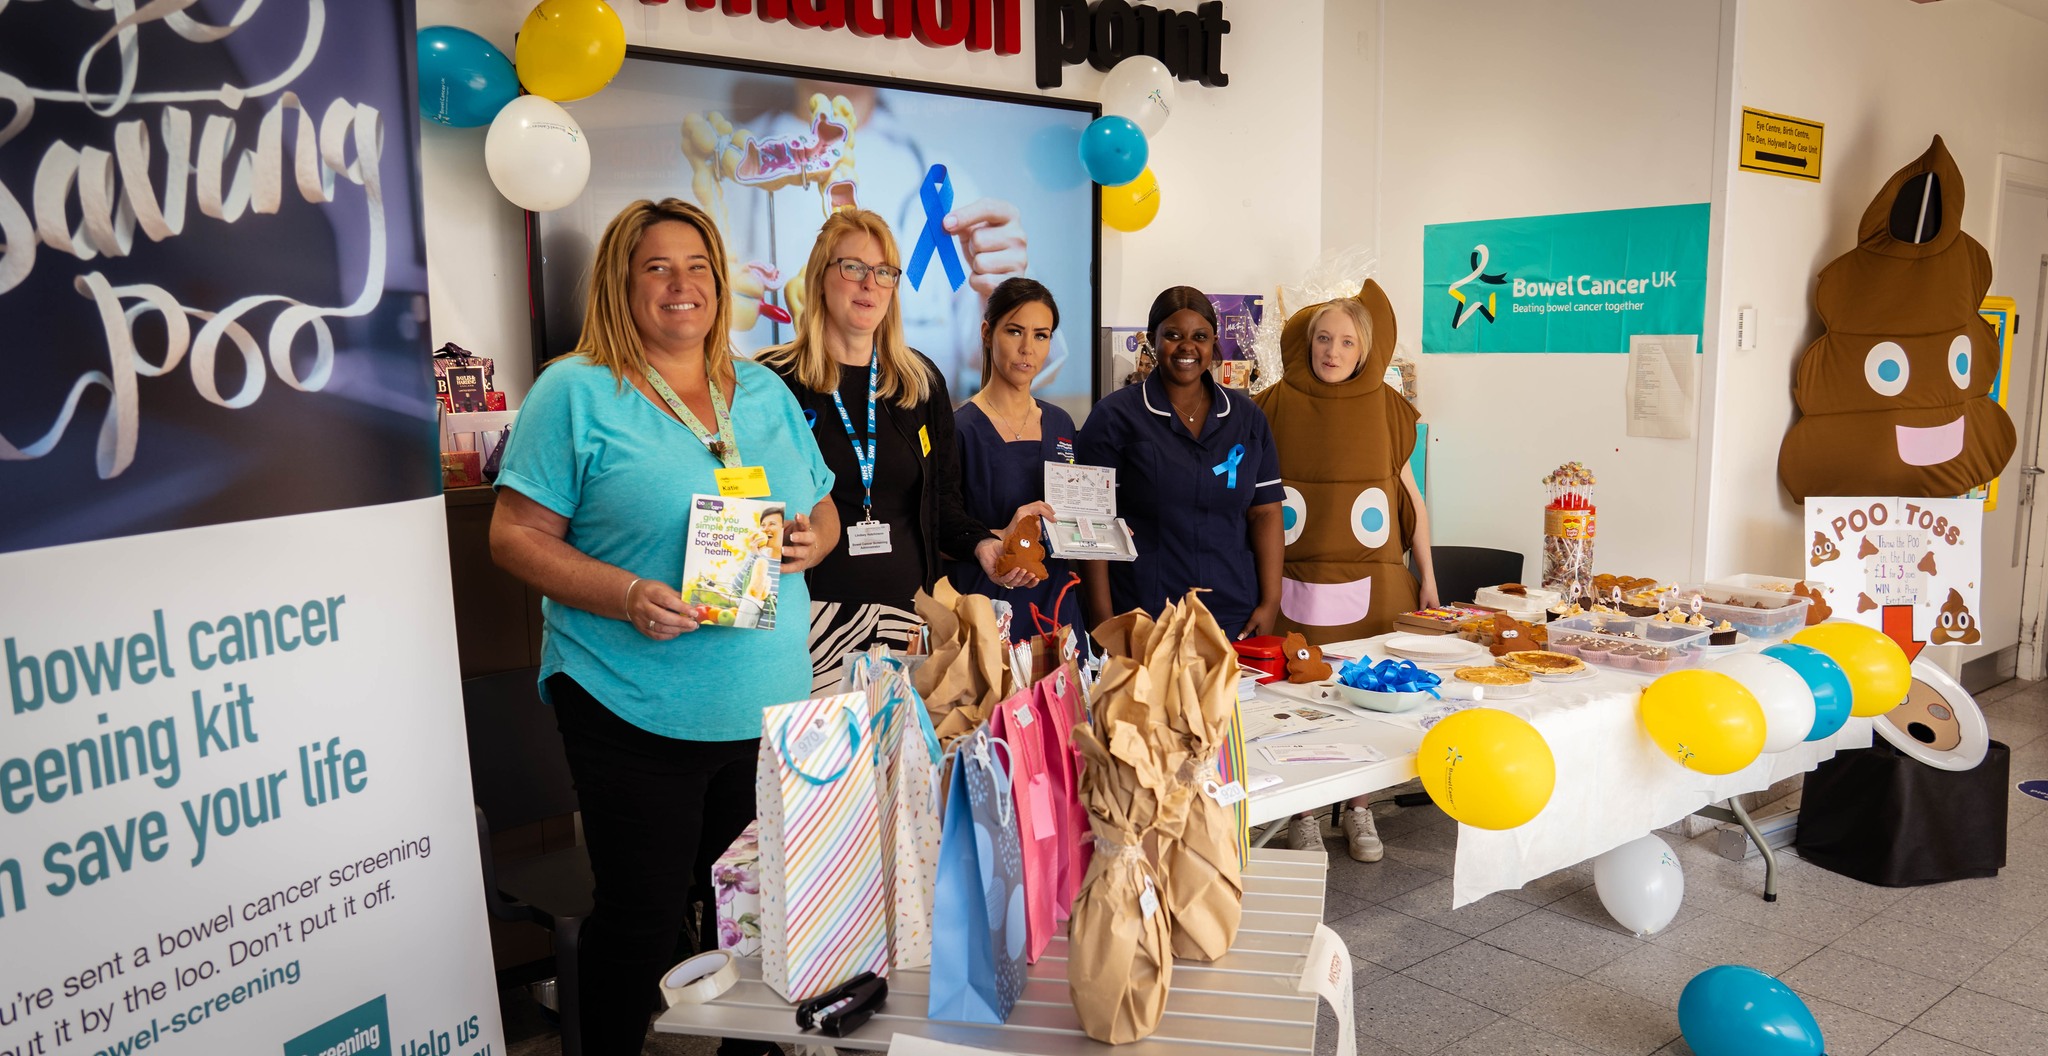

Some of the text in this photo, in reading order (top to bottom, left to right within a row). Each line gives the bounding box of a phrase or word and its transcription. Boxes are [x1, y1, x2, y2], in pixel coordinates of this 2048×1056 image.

[1783, 127, 1794, 136] Birth
[1746, 133, 1755, 142] The
[1767, 138, 1788, 149] Holywell
[1788, 142, 1797, 152] Day
[1798, 144, 1808, 153] Case
[1808, 146, 1818, 155] Unit
[1512, 270, 1677, 298] Bowel Cancer UK
[1512, 301, 1645, 315] Beating bowel cancer together
[73, 271, 335, 479] poo
[695, 521, 749, 535] simple steps
[703, 513, 740, 525] give you
[1831, 502, 1961, 546] POO TOSS
[695, 538, 722, 547] bowel
[697, 530, 735, 541] for good
[1877, 534, 1895, 548] Throw
[1896, 536, 1905, 548] the
[704, 547, 732, 556] health
[1891, 550, 1901, 563] the
[1897, 564, 1905, 580] 3
[1875, 583, 1890, 594] WIN
[3, 594, 347, 716] bowel cancer
[191, 682, 259, 759] kit
[798, 730, 820, 753] 970
[1221, 785, 1240, 800] 920
[43, 810, 170, 897] save
[180, 769, 288, 868] your
[298, 736, 369, 808] life
[62, 951, 125, 998] sent
[133, 946, 151, 968] a
[158, 905, 235, 957] bowel
[242, 875, 323, 922] cancer
[328, 835, 432, 888] screening
[54, 1018, 73, 1047] it
[80, 1002, 115, 1034] by
[122, 980, 167, 1014] the
[174, 961, 221, 991] loo.
[228, 922, 293, 968] Don't
[299, 904, 338, 942] put
[343, 896, 357, 919] it
[363, 879, 396, 910] off.
[92, 959, 301, 1056] wel-screening
[457, 1015, 480, 1047] us
